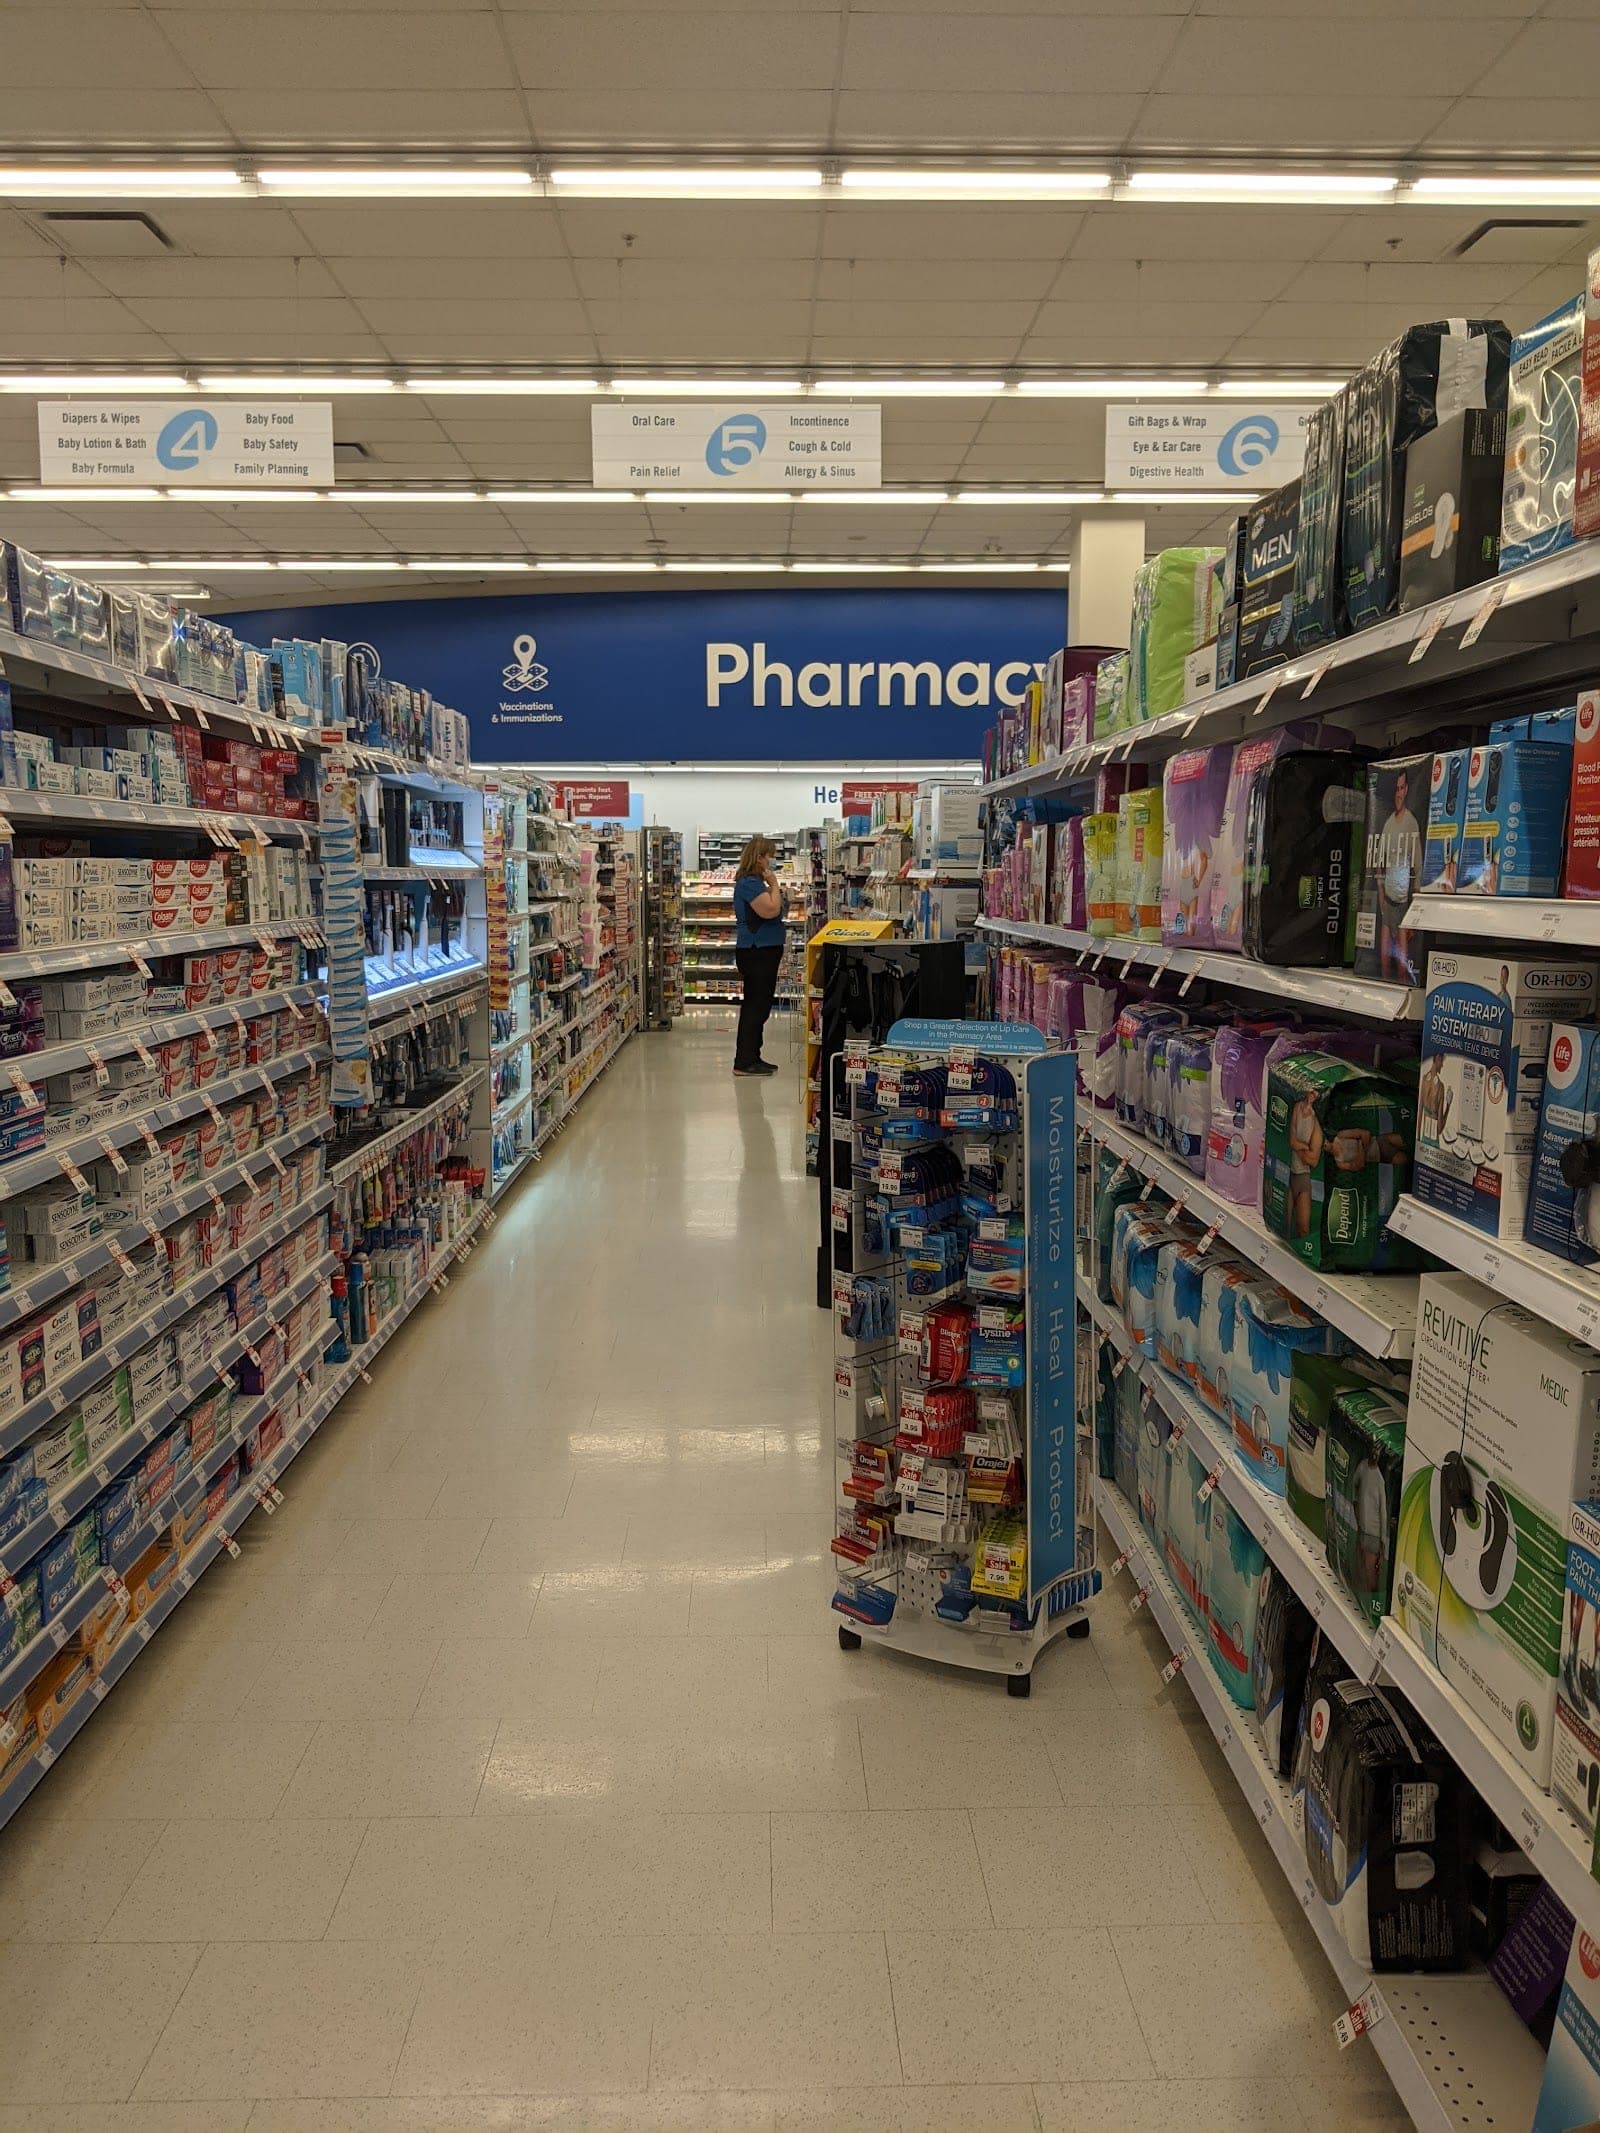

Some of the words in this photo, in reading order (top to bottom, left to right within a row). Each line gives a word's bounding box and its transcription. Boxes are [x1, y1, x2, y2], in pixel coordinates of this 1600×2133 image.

[62, 414, 98, 430] Diapers
[101, 414, 107, 425] &
[111, 414, 140, 428] Wipes
[246, 414, 269, 429] Baby
[272, 414, 295, 425] Food
[632, 415, 652, 427] Oral
[654, 415, 676, 427] Care
[789, 415, 850, 427] Incontinence
[1128, 416, 1144, 429] Gift
[1147, 416, 1169, 430] Bags
[1172, 416, 1179, 428] &
[1183, 416, 1207, 430] Wrap
[58, 439, 81, 454] Baby
[83, 438, 112, 450] Lotion
[115, 438, 123, 450] &
[126, 438, 147, 450] Bath
[242, 439, 266, 455] Baby
[268, 439, 298, 454] Safety
[788, 440, 817, 454] Cough
[820, 440, 828, 452] &
[830, 440, 852, 452] Cold
[1133, 441, 1147, 455] Eye
[1151, 441, 1159, 452] &
[1162, 441, 1177, 452] Ear
[1180, 441, 1202, 452] Care
[72, 463, 94, 478] Baby
[97, 463, 135, 476] Formula
[234, 464, 264, 480] Family
[268, 464, 308, 480] Planning
[630, 466, 651, 478] Pain
[653, 465, 681, 478] Relief
[785, 466, 817, 480] Allergy
[820, 466, 828, 478] &
[831, 465, 856, 478] Sinus
[1129, 466, 1170, 480] Digestive
[1174, 465, 1205, 479] Health
[1403, 505, 1434, 531] SHIELDS
[1251, 529, 1293, 571] MEN
[499, 701, 554, 712] Vaccinations
[491, 714, 500, 723] &
[501, 713, 563, 723] Immunizations
[1577, 763, 1597, 776] Blood
[1366, 832, 1396, 869] REAL
[156, 861, 174, 870] Colgate
[1327, 849, 1343, 934] GUARDS
[155, 912, 175, 922] Colgate
[1530, 974, 1588, 988] DR-HO'S
[1432, 994, 1456, 1015] PAIN
[1457, 999, 1506, 1024] THERAPY
[904, 1021, 922, 1033] Shop
[930, 1021, 957, 1032] Greater
[959, 1021, 989, 1033] Selection
[991, 1023, 999, 1033] of
[1000, 1022, 1011, 1034] Lip
[1013, 1024, 1030, 1035] Care
[1430, 1014, 1468, 1038] SYSTEM
[929, 1030, 936, 1039] in
[937, 1031, 948, 1040] the
[950, 1031, 984, 1042] Pharmacy
[986, 1032, 1003, 1042] Area
[1430, 1033, 1463, 1051] PROFESSIONAL
[1481, 1047, 1502, 1060] DEVICE
[1555, 1045, 1571, 1059] Life
[849, 1059, 866, 1068] Sale
[953, 1064, 970, 1074] Sale
[881, 1082, 898, 1091] Sale
[883, 1170, 899, 1179] Sale
[1048, 1096, 1065, 1262] Moisturize
[51, 1203, 80, 1224] SENSODYNE
[1336, 1191, 1351, 1241] Depend
[60, 1230, 88, 1252] SENSODYNE
[52, 1312, 70, 1329] Crest
[903, 1329, 919, 1341] Sale
[1422, 1299, 1491, 1370] REVITIVE
[1049, 1307, 1064, 1381] Heal
[1420, 1331, 1459, 1364] CIRCULATION
[54, 1343, 74, 1361] Crest
[134, 1384, 162, 1412] SENSODYNE
[1539, 1373, 1570, 1408] MEDIC
[84, 1391, 114, 1420] SENSODYNE
[903, 1409, 921, 1420] Sale
[92, 1420, 119, 1449] SENSODYNE
[36, 1437, 67, 1466] SENSODYNE
[976, 1456, 1010, 1469] Orajel
[902, 1469, 919, 1482] Sale
[1048, 1424, 1064, 1543] Protect
[987, 1560, 1006, 1571] Sale
[1570, 1550, 1595, 1577] FOOT
[989, 1573, 1005, 1582] 7.99
[1569, 1568, 1588, 1593] PAIN
[1350, 2008, 1364, 2032] Sale
